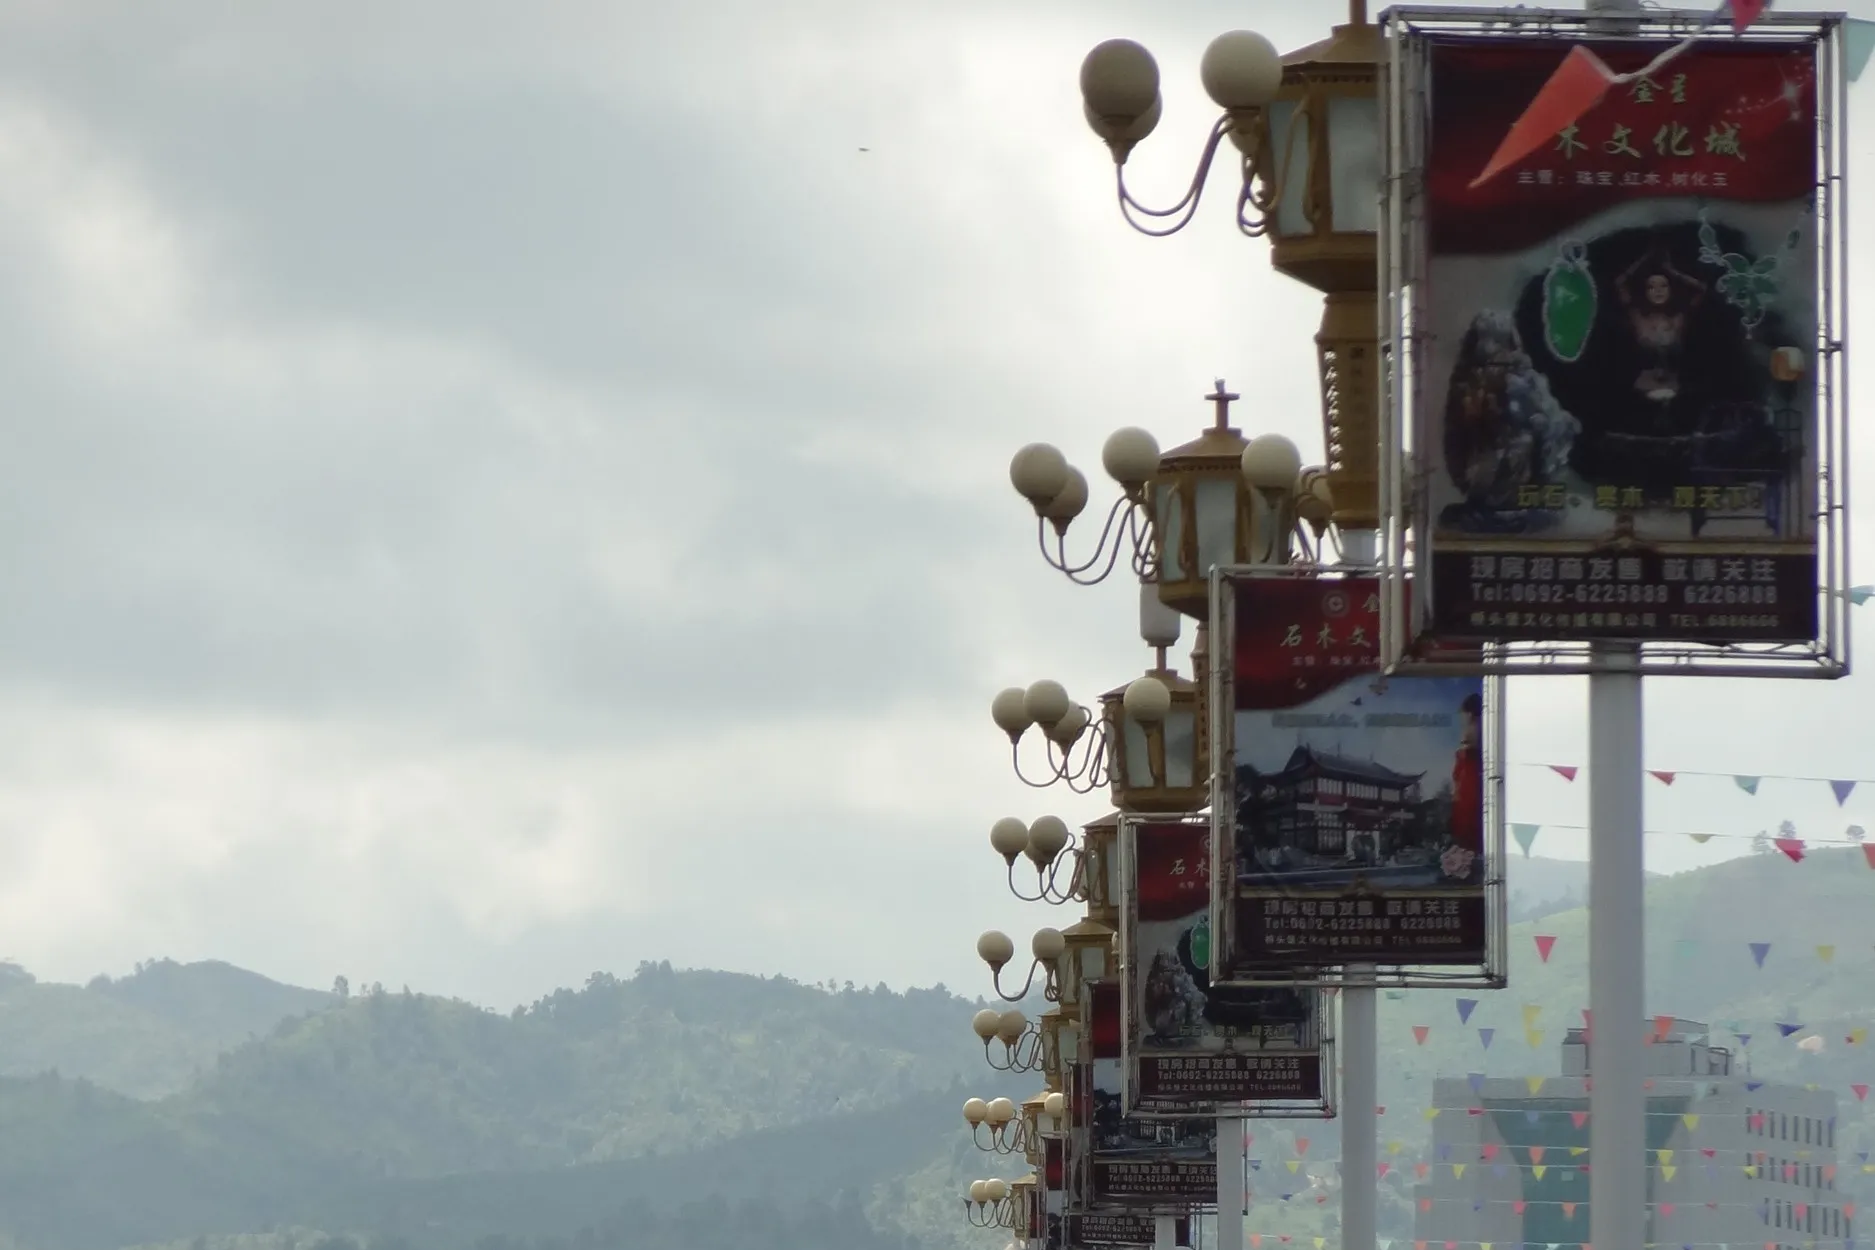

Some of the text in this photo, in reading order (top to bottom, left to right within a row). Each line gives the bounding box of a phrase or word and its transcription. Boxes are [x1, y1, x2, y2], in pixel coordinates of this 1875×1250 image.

[1554, 120, 1746, 162] 木文化城
[1662, 556, 1777, 581] 敬请关注
[1361, 592, 1380, 613] 金
[1280, 623, 1372, 648] 石木文
[1169, 857, 1210, 877] 石木
